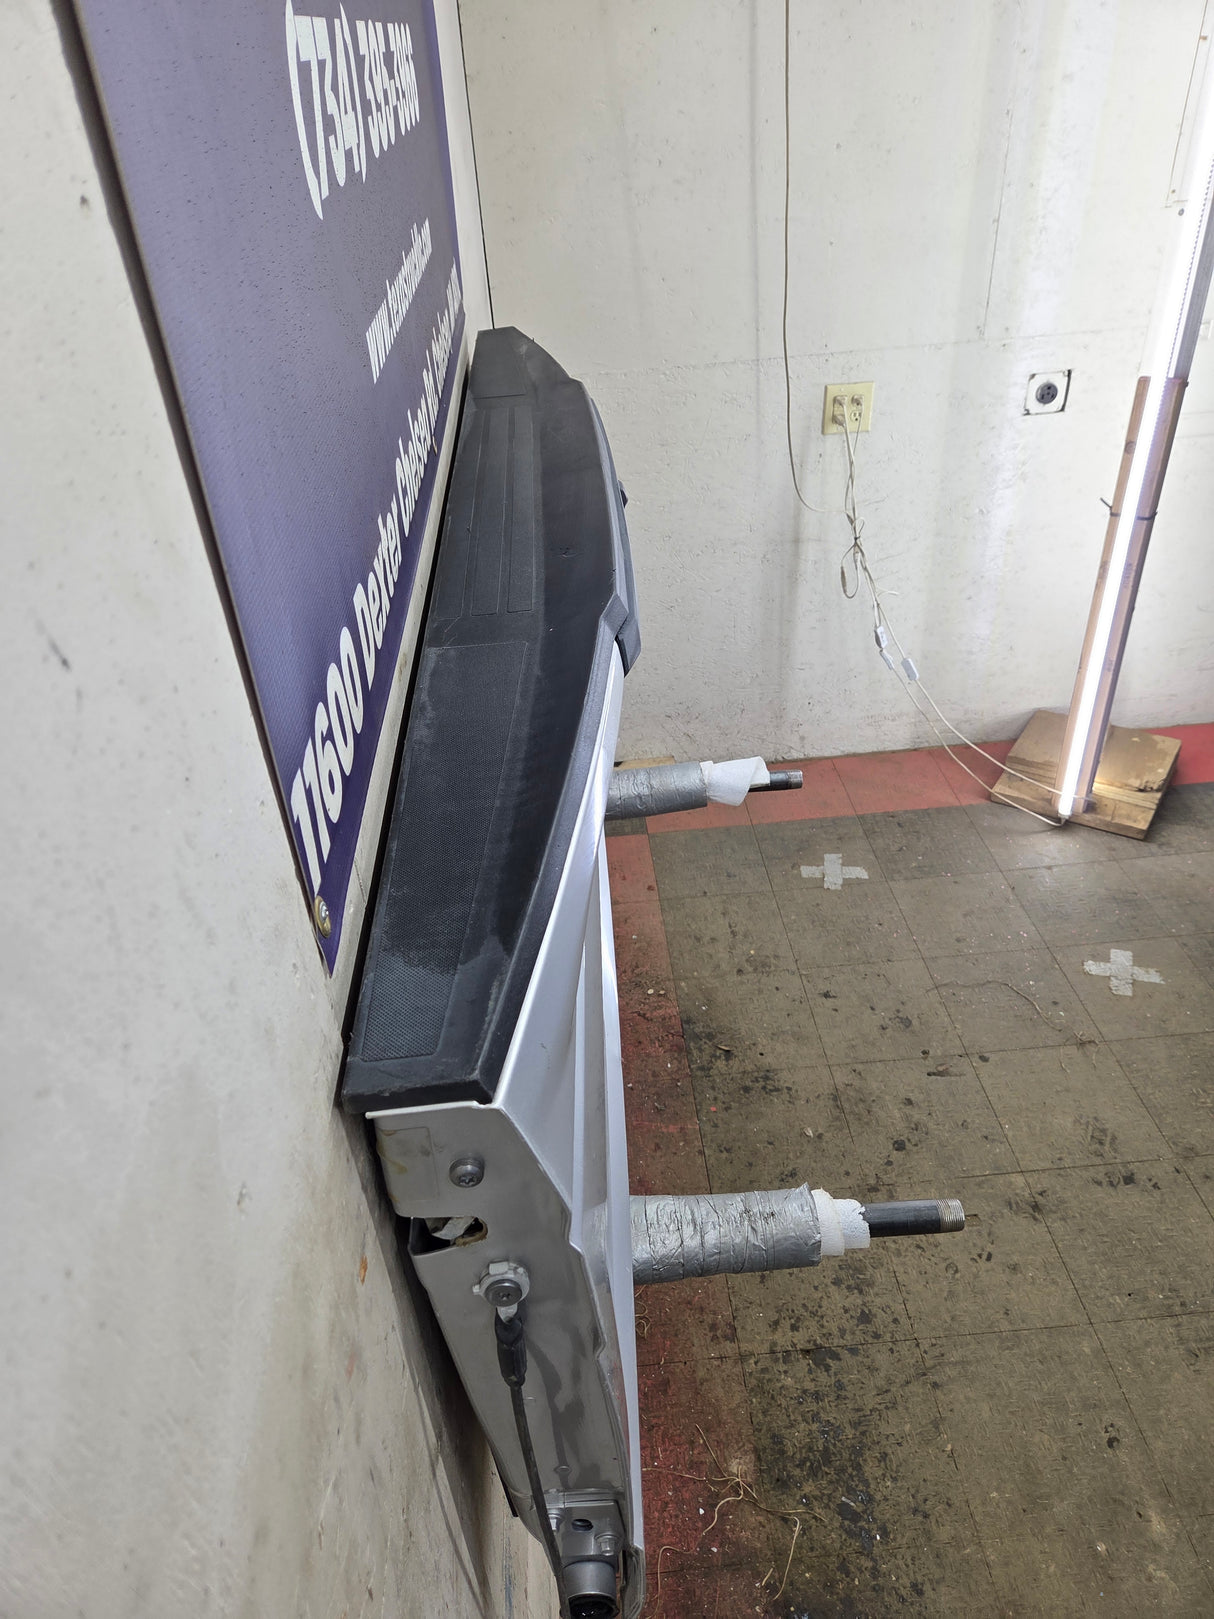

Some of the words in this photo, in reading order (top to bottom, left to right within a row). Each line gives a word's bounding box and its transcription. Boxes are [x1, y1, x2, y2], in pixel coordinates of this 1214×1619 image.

[285, 0, 367, 220] (734)
[355, 18, 420, 158] 395-3966
[290, 625, 364, 898] 11600
[353, 492, 402, 690] Dexter
[396, 394, 431, 537] Chelsea
